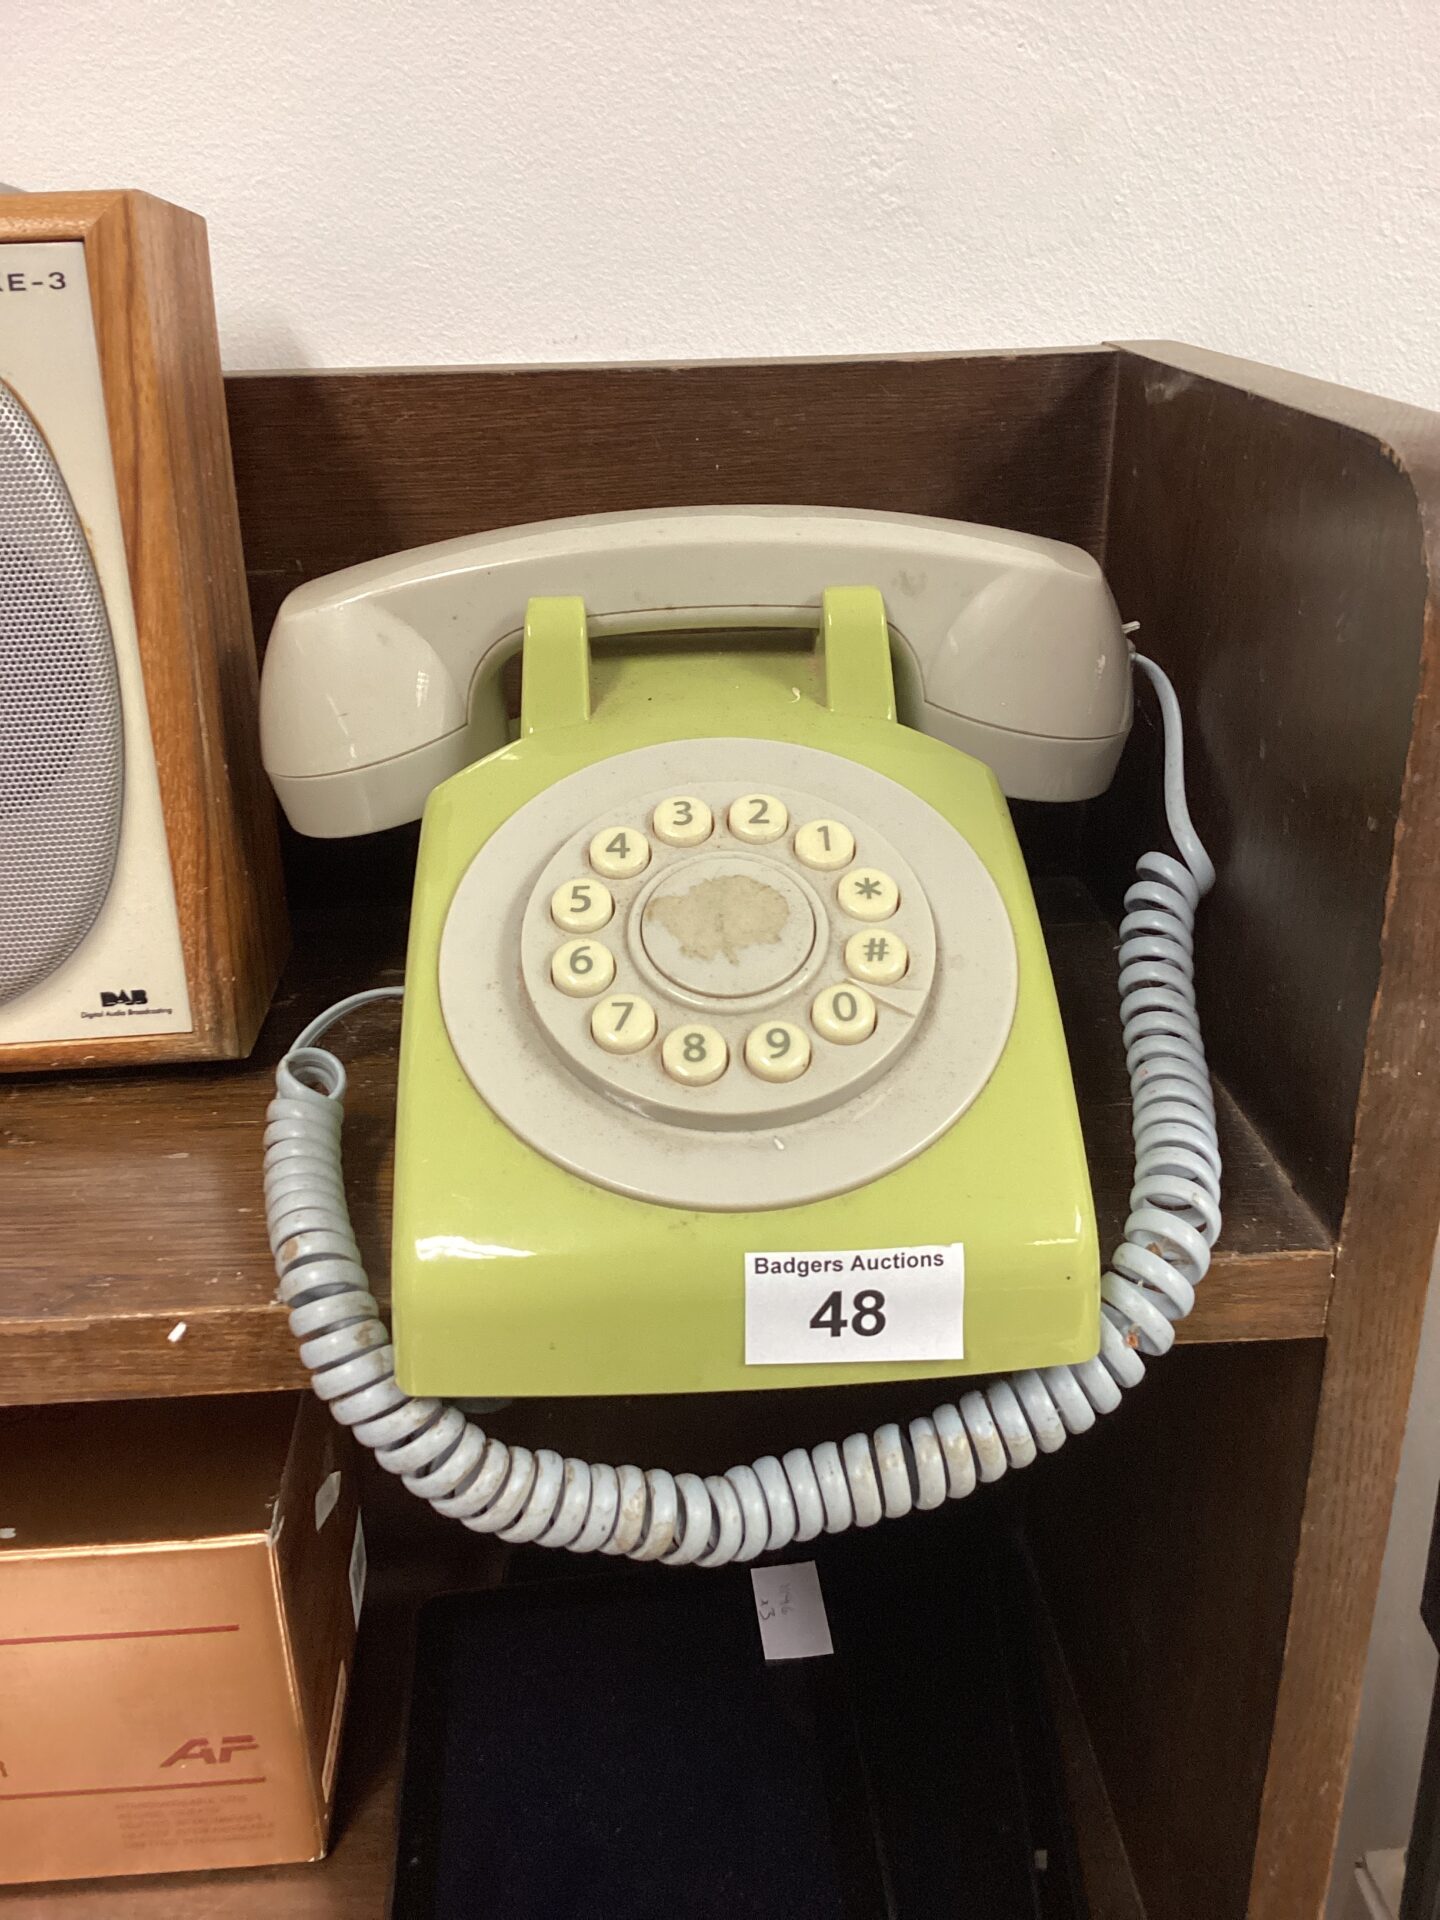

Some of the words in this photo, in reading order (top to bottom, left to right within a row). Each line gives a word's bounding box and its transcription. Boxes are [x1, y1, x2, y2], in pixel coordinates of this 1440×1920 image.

[0, 271, 67, 292] E-3
[672, 801, 694, 826] 3
[748, 799, 771, 825] 2
[605, 832, 631, 859] 4
[816, 825, 832, 852] 1
[569, 885, 592, 913] 5
[569, 946, 594, 975] 6
[100, 989, 148, 1007] DAB
[832, 991, 858, 1022] 0
[611, 1001, 634, 1032] 7
[682, 1033, 707, 1063] 8
[765, 1028, 791, 1060] 9
[754, 1257, 844, 1278] Badgers
[850, 1252, 945, 1272] Auctions
[809, 1289, 887, 1338] 48
[159, 1734, 260, 1769] AF
